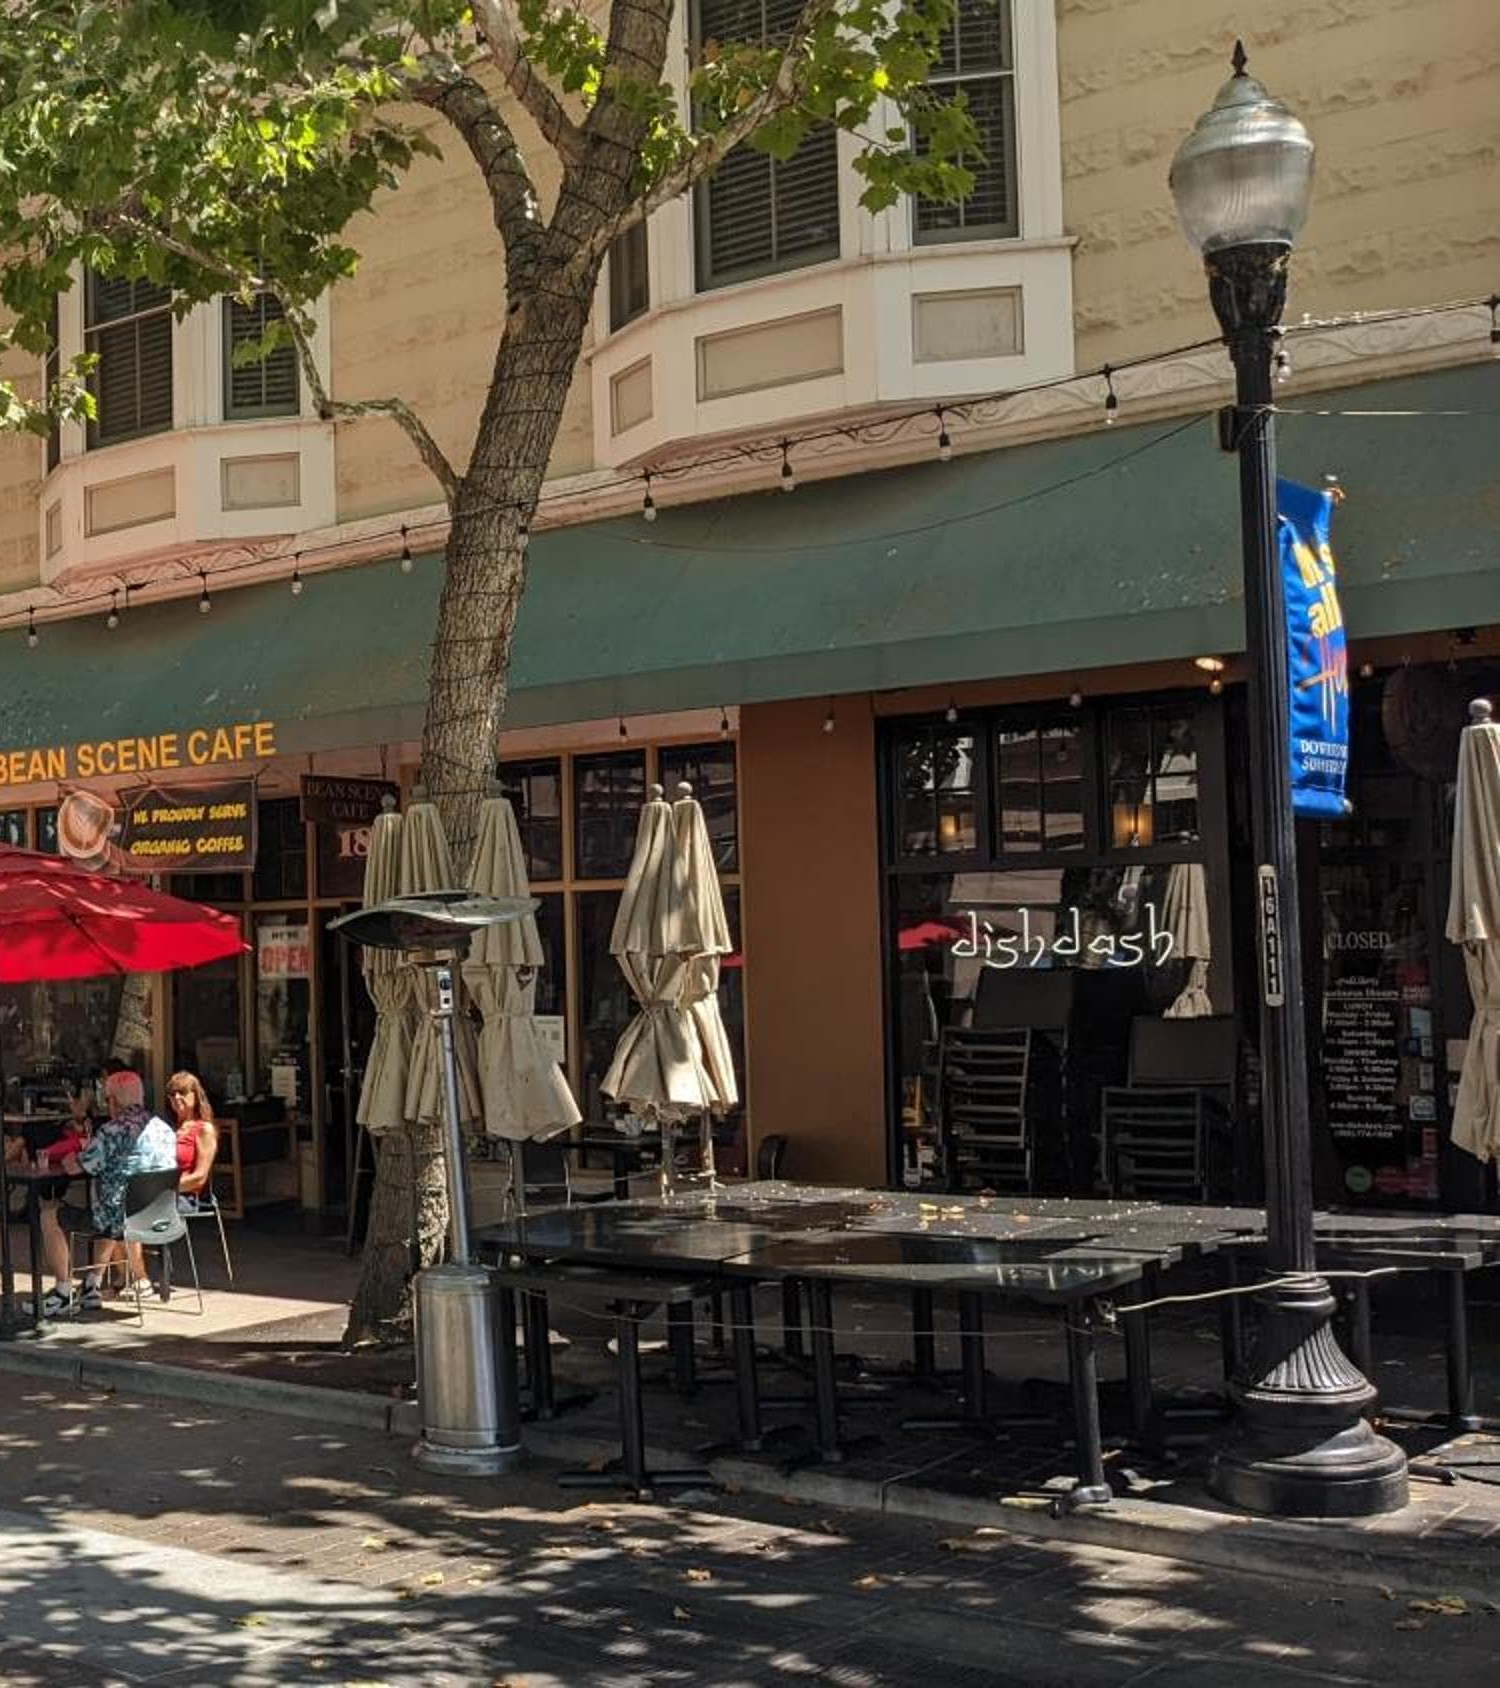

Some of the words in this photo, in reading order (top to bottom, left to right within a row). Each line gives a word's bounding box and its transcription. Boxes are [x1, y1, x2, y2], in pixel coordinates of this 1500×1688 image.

[77, 734, 180, 777] SCENE
[187, 721, 277, 765] CAFE
[196, 836, 244, 854] COFFEE
[950, 903, 1174, 968] dishdash
[1327, 931, 1391, 950] CLOSED
